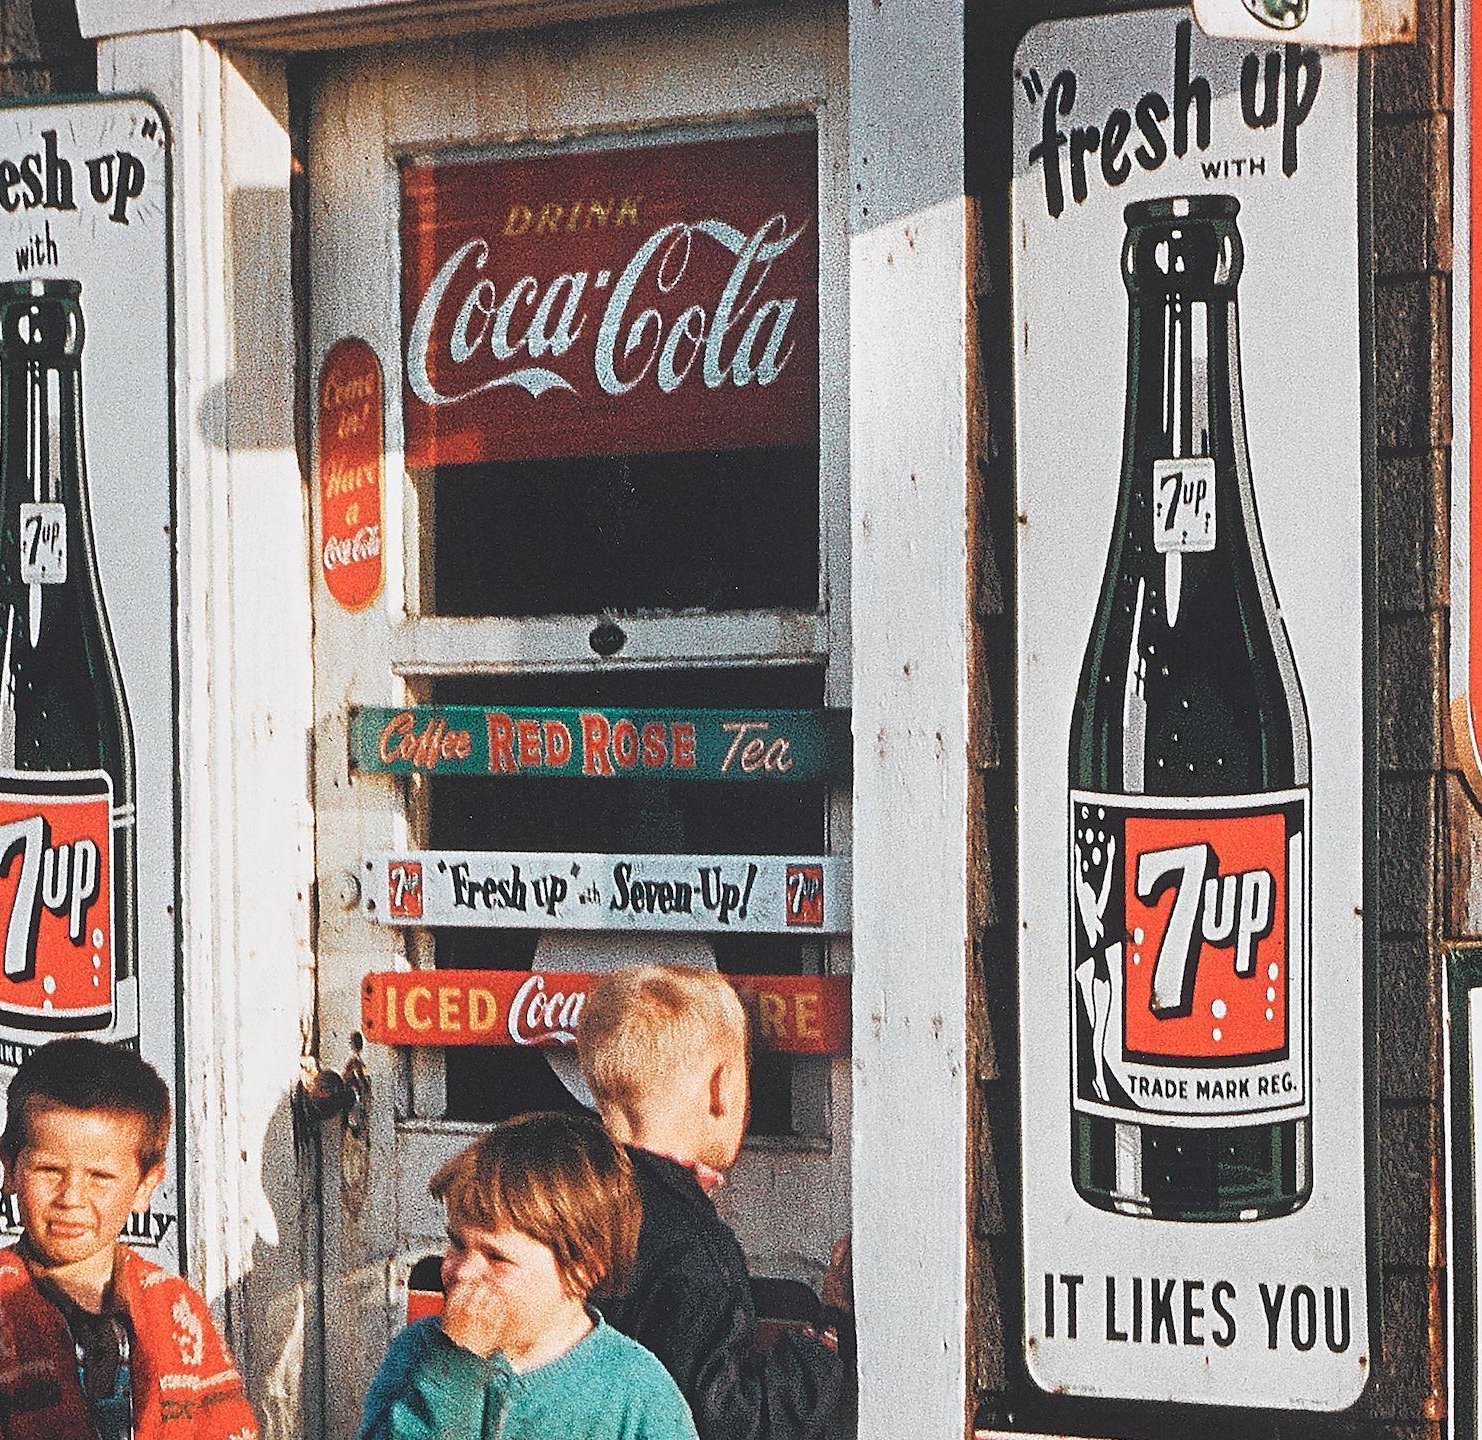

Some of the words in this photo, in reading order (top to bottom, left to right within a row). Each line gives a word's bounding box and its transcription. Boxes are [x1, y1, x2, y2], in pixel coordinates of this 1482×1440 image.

[1022, 18, 1212, 219] "fresh
[1201, 157, 1266, 180] WITH
[15, 220, 59, 272] with
[406, 212, 809, 405] Coca-Cola
[376, 711, 472, 771] Coffee
[486, 712, 573, 775] RED
[580, 711, 696, 776] ROSE
[721, 720, 795, 774] Tea
[609, 860, 758, 925] Seven-Up!
[384, 986, 497, 1032] ICED
[507, 975, 587, 1047] Coca
[759, 991, 821, 1040] RE
[1127, 1074, 1188, 1100] TRADE
[1196, 1078, 1250, 1101] MARK
[1257, 1071, 1298, 1097] REG.
[1043, 1274, 1085, 1340] IT
[1106, 1276, 1238, 1347] LIKES
[1257, 1284, 1352, 1353] YOU
